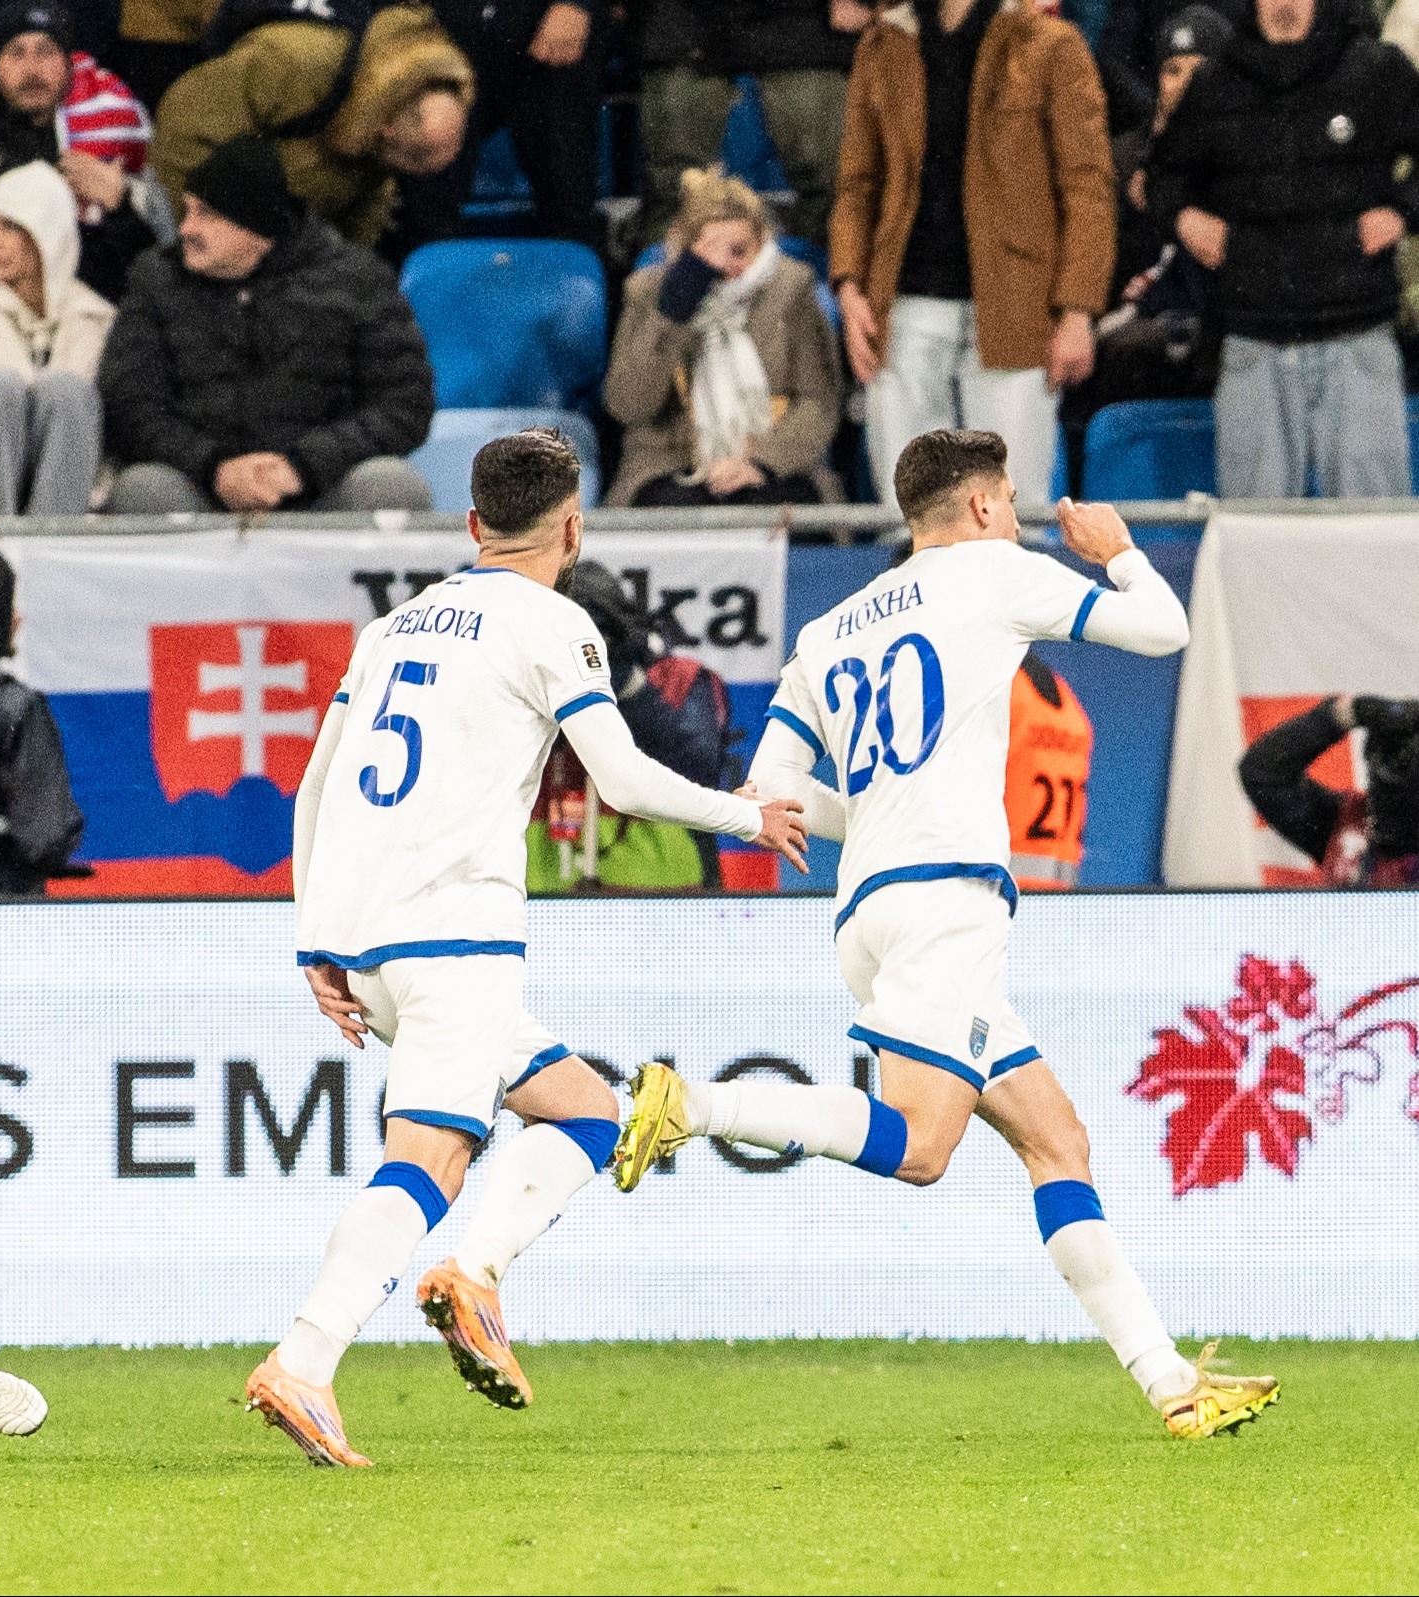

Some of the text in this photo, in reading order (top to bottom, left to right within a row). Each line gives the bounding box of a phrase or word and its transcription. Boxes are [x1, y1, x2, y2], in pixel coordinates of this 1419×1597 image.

[833, 581, 924, 641] HOXHA
[358, 660, 439, 807] 5
[824, 632, 945, 797] 20
